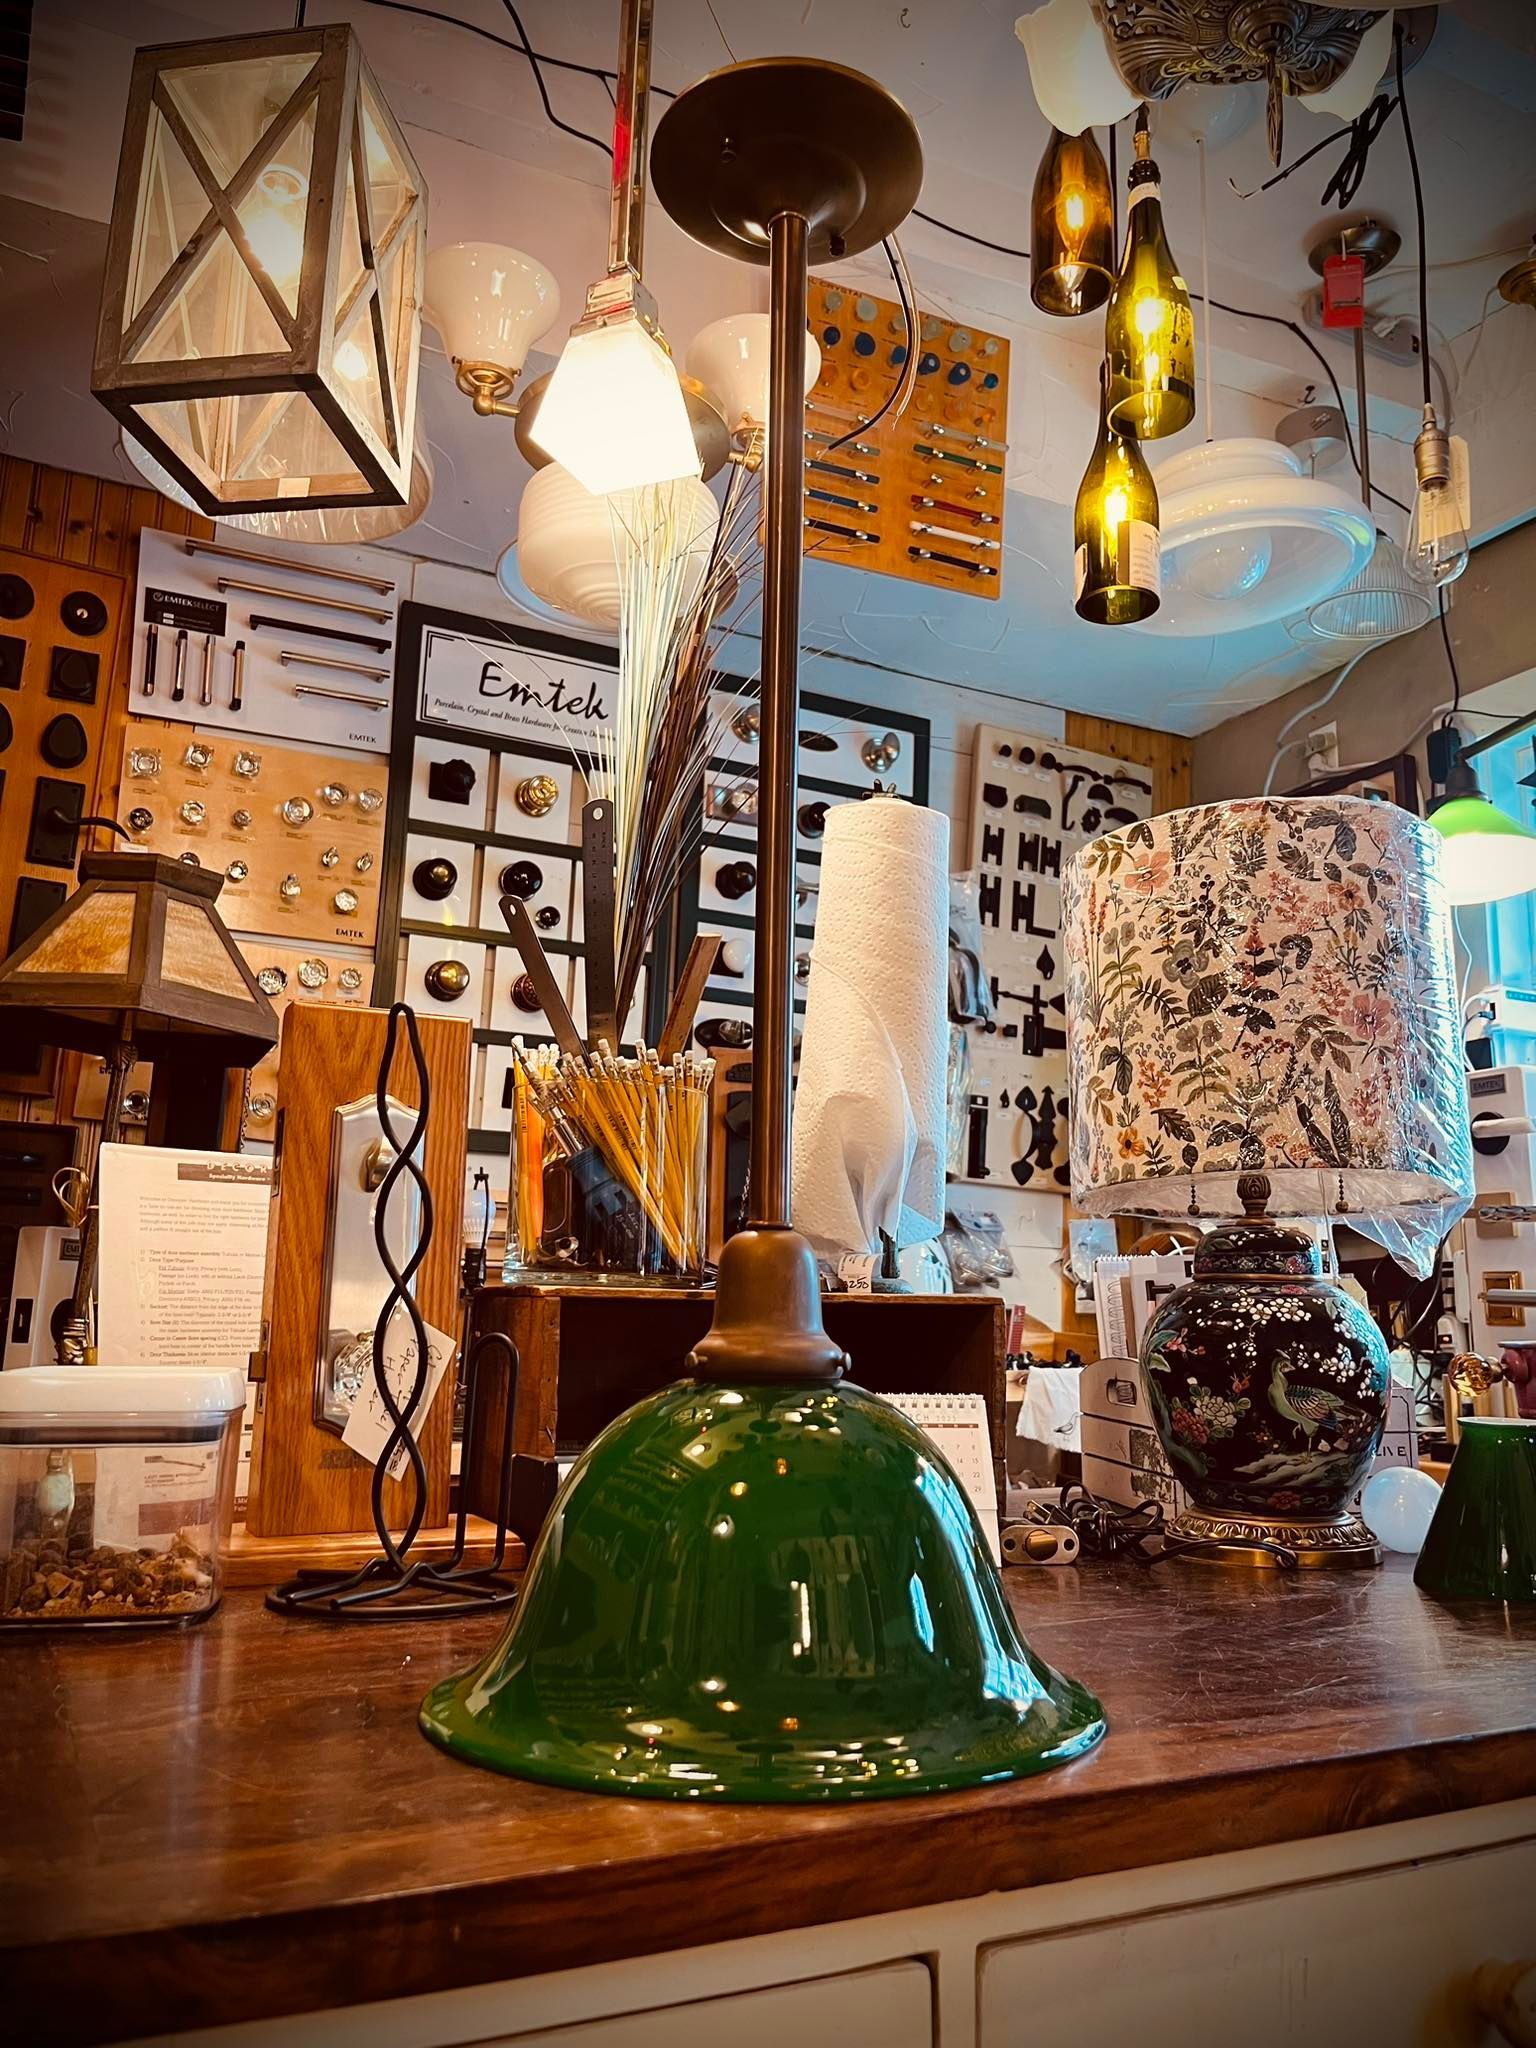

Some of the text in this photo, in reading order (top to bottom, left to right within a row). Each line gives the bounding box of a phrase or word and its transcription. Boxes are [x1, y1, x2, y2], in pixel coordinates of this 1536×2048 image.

[478, 661, 609, 720] Emtek
[467, 704, 490, 717] Crystal
[490, 710, 503, 719] and
[521, 716, 551, 729] Hardware
[349, 732, 377, 743] EMTEK
[335, 928, 364, 938] EMTEK
